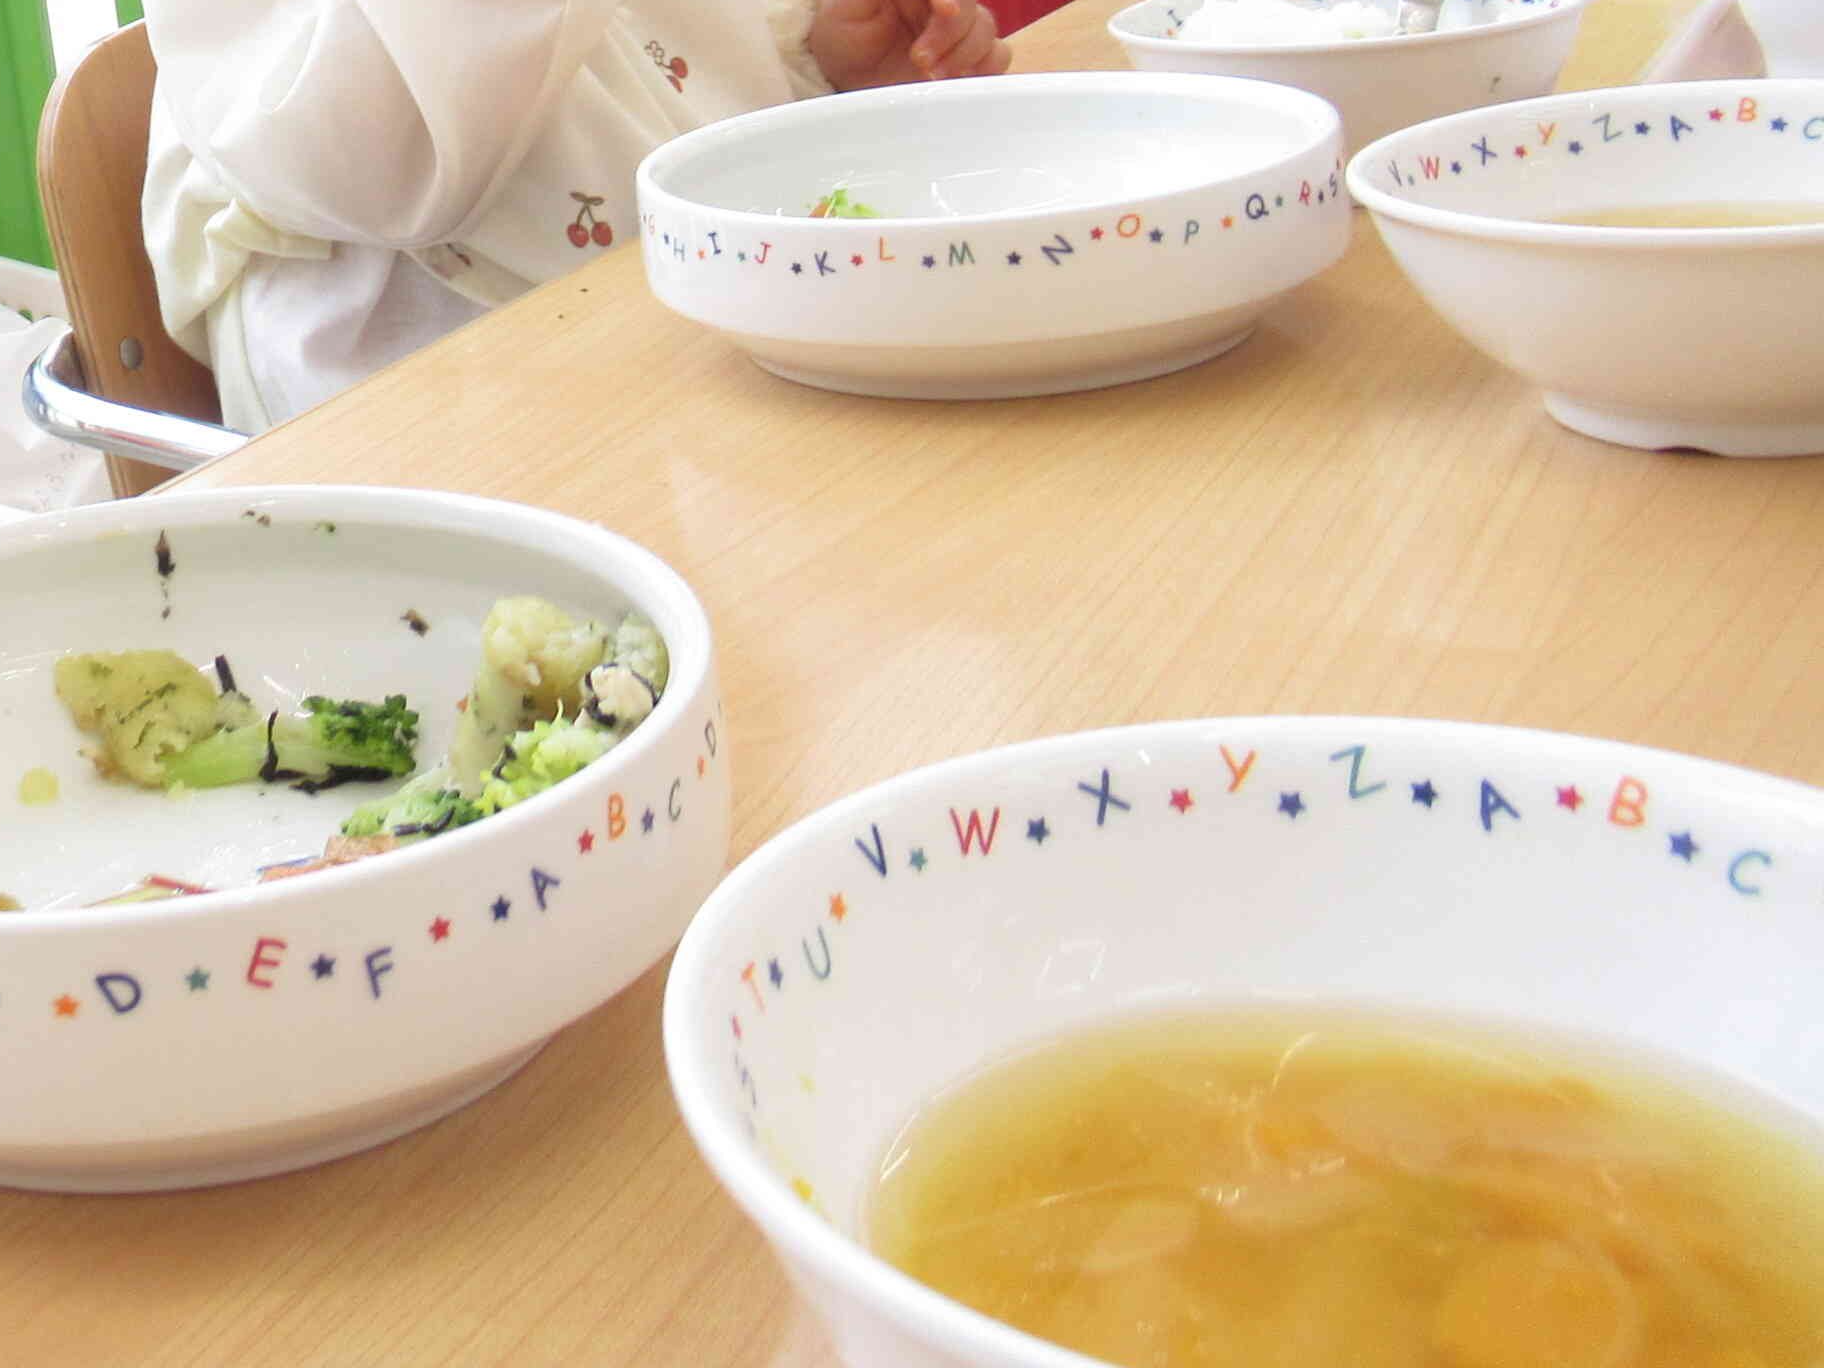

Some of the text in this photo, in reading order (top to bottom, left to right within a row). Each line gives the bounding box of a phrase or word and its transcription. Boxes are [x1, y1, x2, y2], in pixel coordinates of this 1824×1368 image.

[1419, 157, 1440, 180] W
[1472, 136, 1497, 166] X
[1538, 123, 1555, 146] Y
[1592, 113, 1622, 142] Z
[1670, 115, 1693, 141] A
[1736, 97, 1757, 122] B
[1803, 116, 1824, 140] C
[707, 231, 721, 256] I
[755, 242, 771, 264] J
[815, 251, 836, 276] K
[879, 237, 895, 261] L
[949, 241, 975, 267] M
[1041, 235, 1074, 266] N
[1116, 214, 1140, 238] O
[1184, 220, 1199, 244] P
[1245, 194, 1269, 220] Q
[95, 973, 142, 1014] D
[246, 938, 287, 989] E
[364, 947, 393, 999] F
[531, 868, 560, 911] A
[608, 794, 626, 840] B
[668, 778, 681, 822] C
[802, 926, 831, 981] U
[856, 825, 887, 877] V
[950, 808, 1000, 856] W
[1078, 769, 1130, 826] X
[1221, 747, 1256, 793] Y
[1330, 746, 1386, 800] Z
[1480, 779, 1520, 832] A
[1607, 777, 1648, 828] B
[1727, 848, 1772, 896] C
